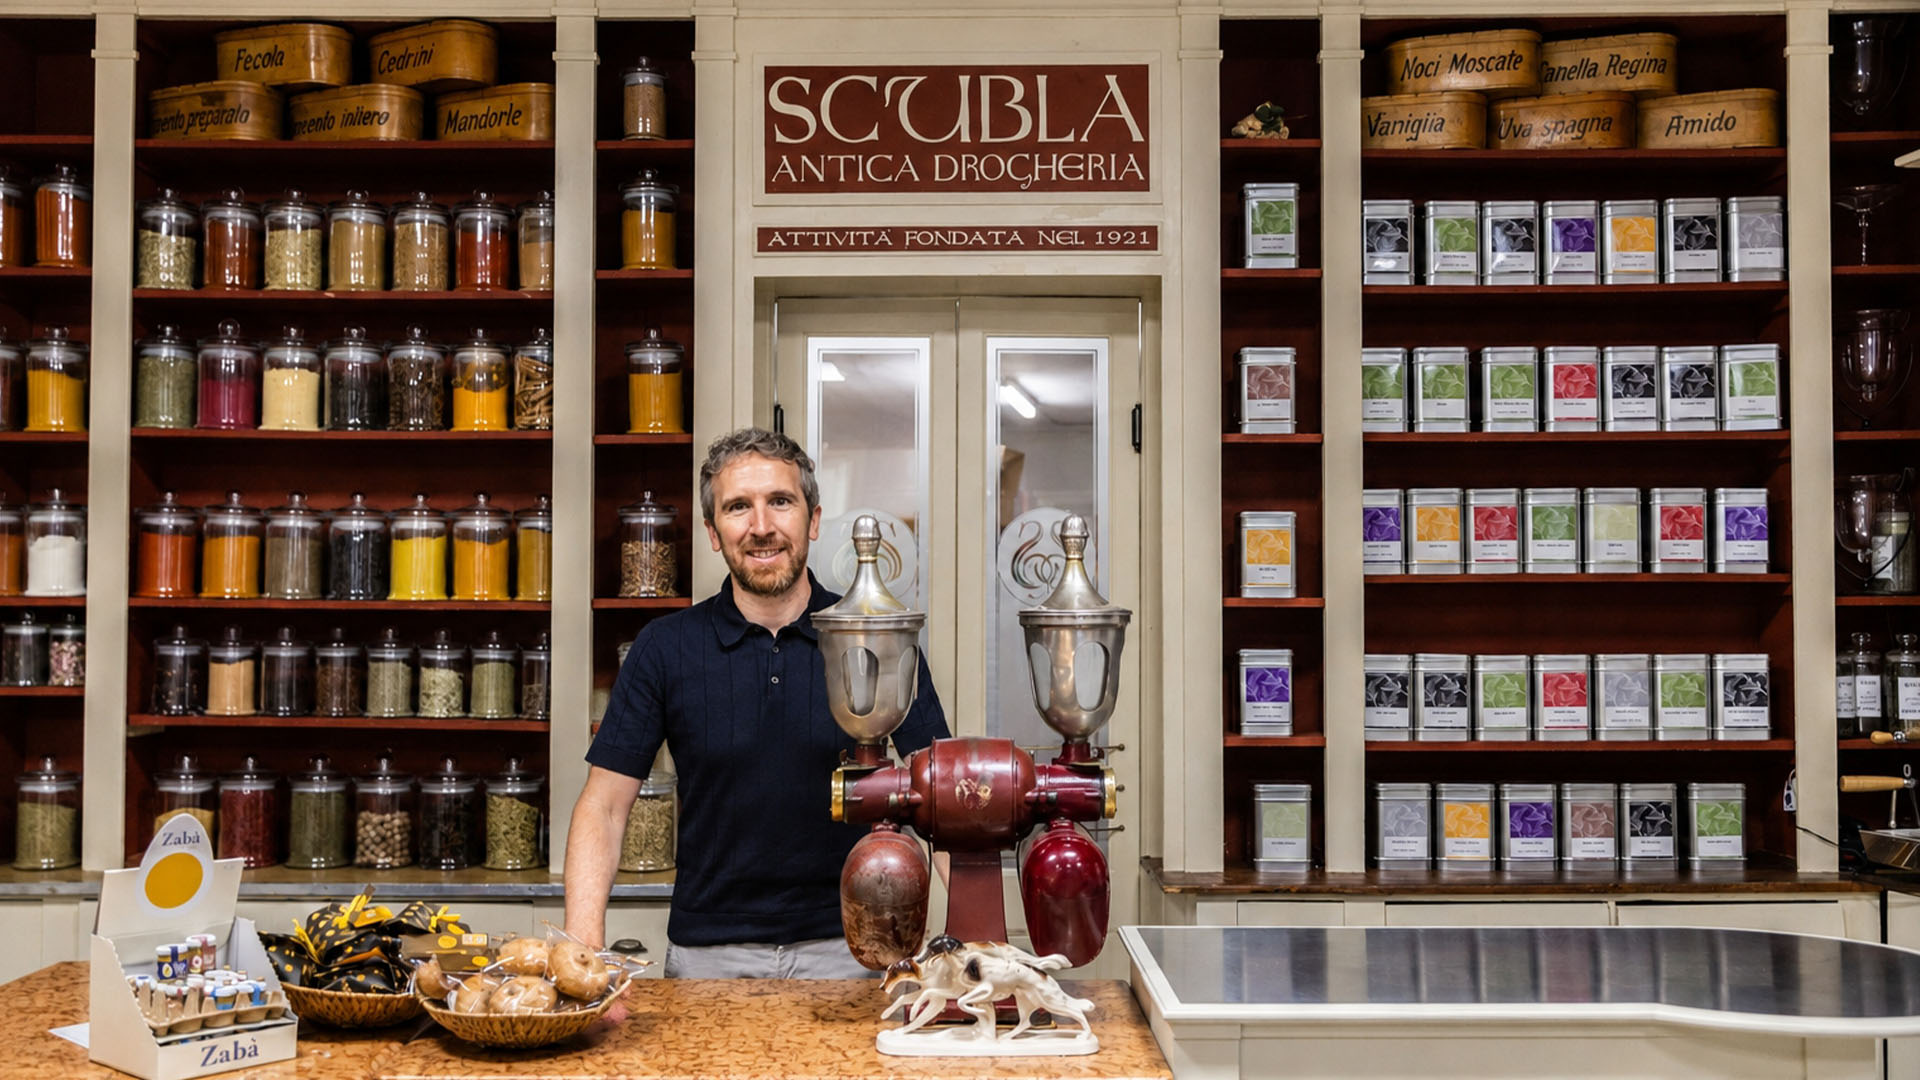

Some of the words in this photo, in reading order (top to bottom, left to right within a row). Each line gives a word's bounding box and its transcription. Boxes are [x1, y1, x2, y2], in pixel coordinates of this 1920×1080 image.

[234, 44, 284, 73] Fecola
[377, 42, 435, 75] Cedrini
[1400, 54, 1440, 81] Noci
[1448, 49, 1524, 75] Moscate
[1605, 52, 1668, 80] Regina
[444, 103, 522, 134] Mandorle
[768, 75, 1145, 143] SCUBLA
[1665, 109, 1737, 137] Amido
[1498, 117, 1532, 140] Uva
[1541, 115, 1613, 141] spagna
[771, 153, 920, 183] ANTICA
[934, 153, 1145, 190] DROGHERIA
[904, 229, 1025, 249] FONDATA
[1038, 229, 1085, 246] NEL
[1095, 229, 1151, 246] 1921
[162, 831, 201, 846] Zabà
[200, 1037, 259, 1067] Zabà
